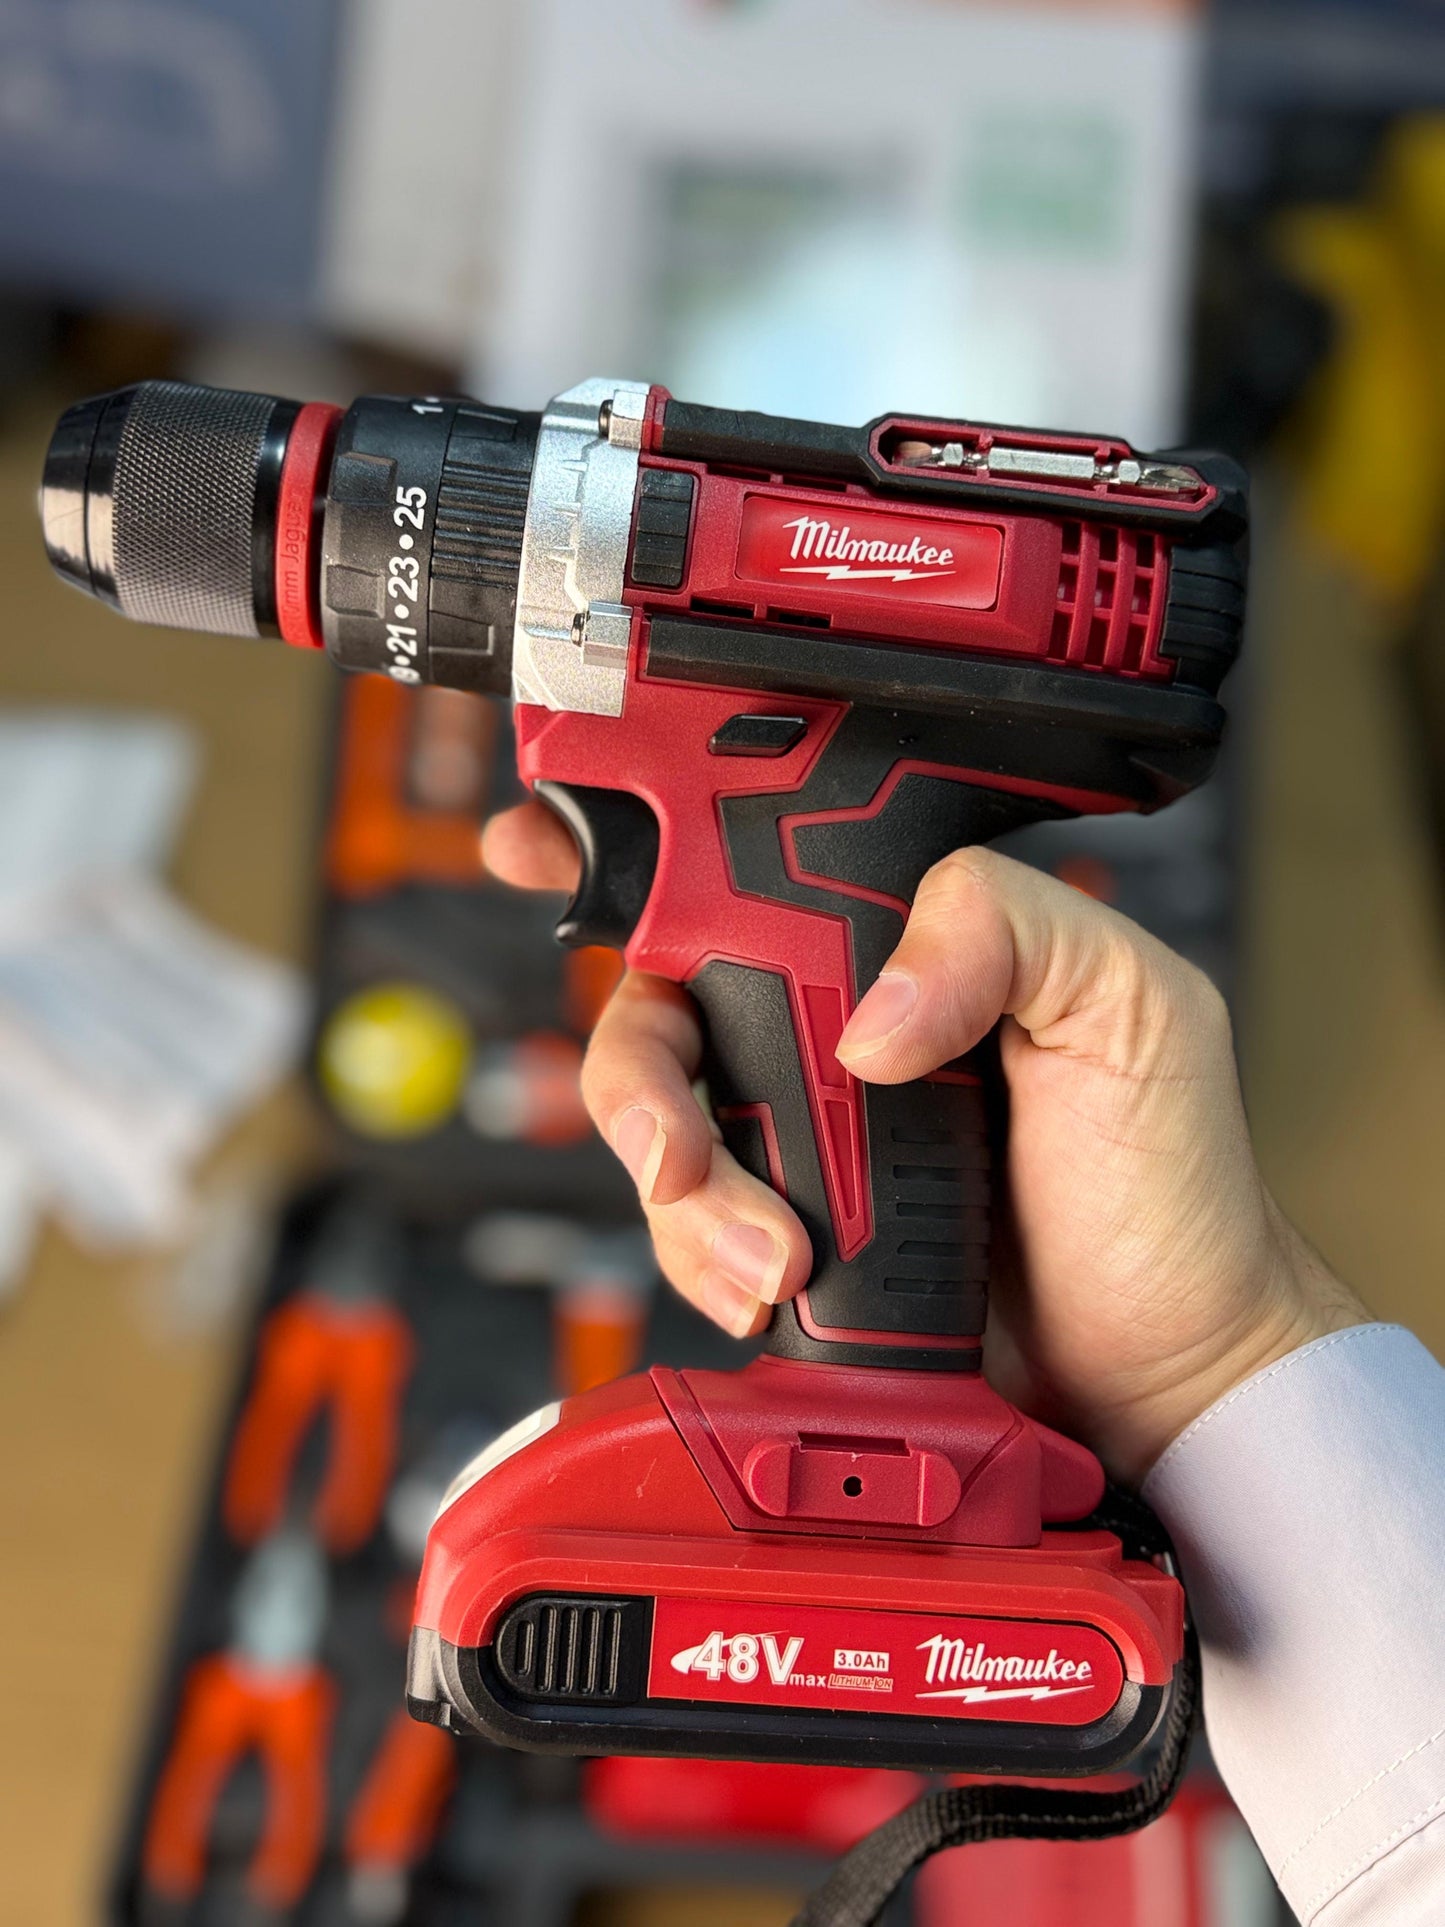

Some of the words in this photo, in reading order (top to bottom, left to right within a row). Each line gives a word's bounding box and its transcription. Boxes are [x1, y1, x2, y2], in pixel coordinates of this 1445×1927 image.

[393, 486, 427, 530] 25
[387, 556, 420, 602] 23
[386, 623, 418, 657] 21
[837, 1652, 886, 1669] 3.0Ah
